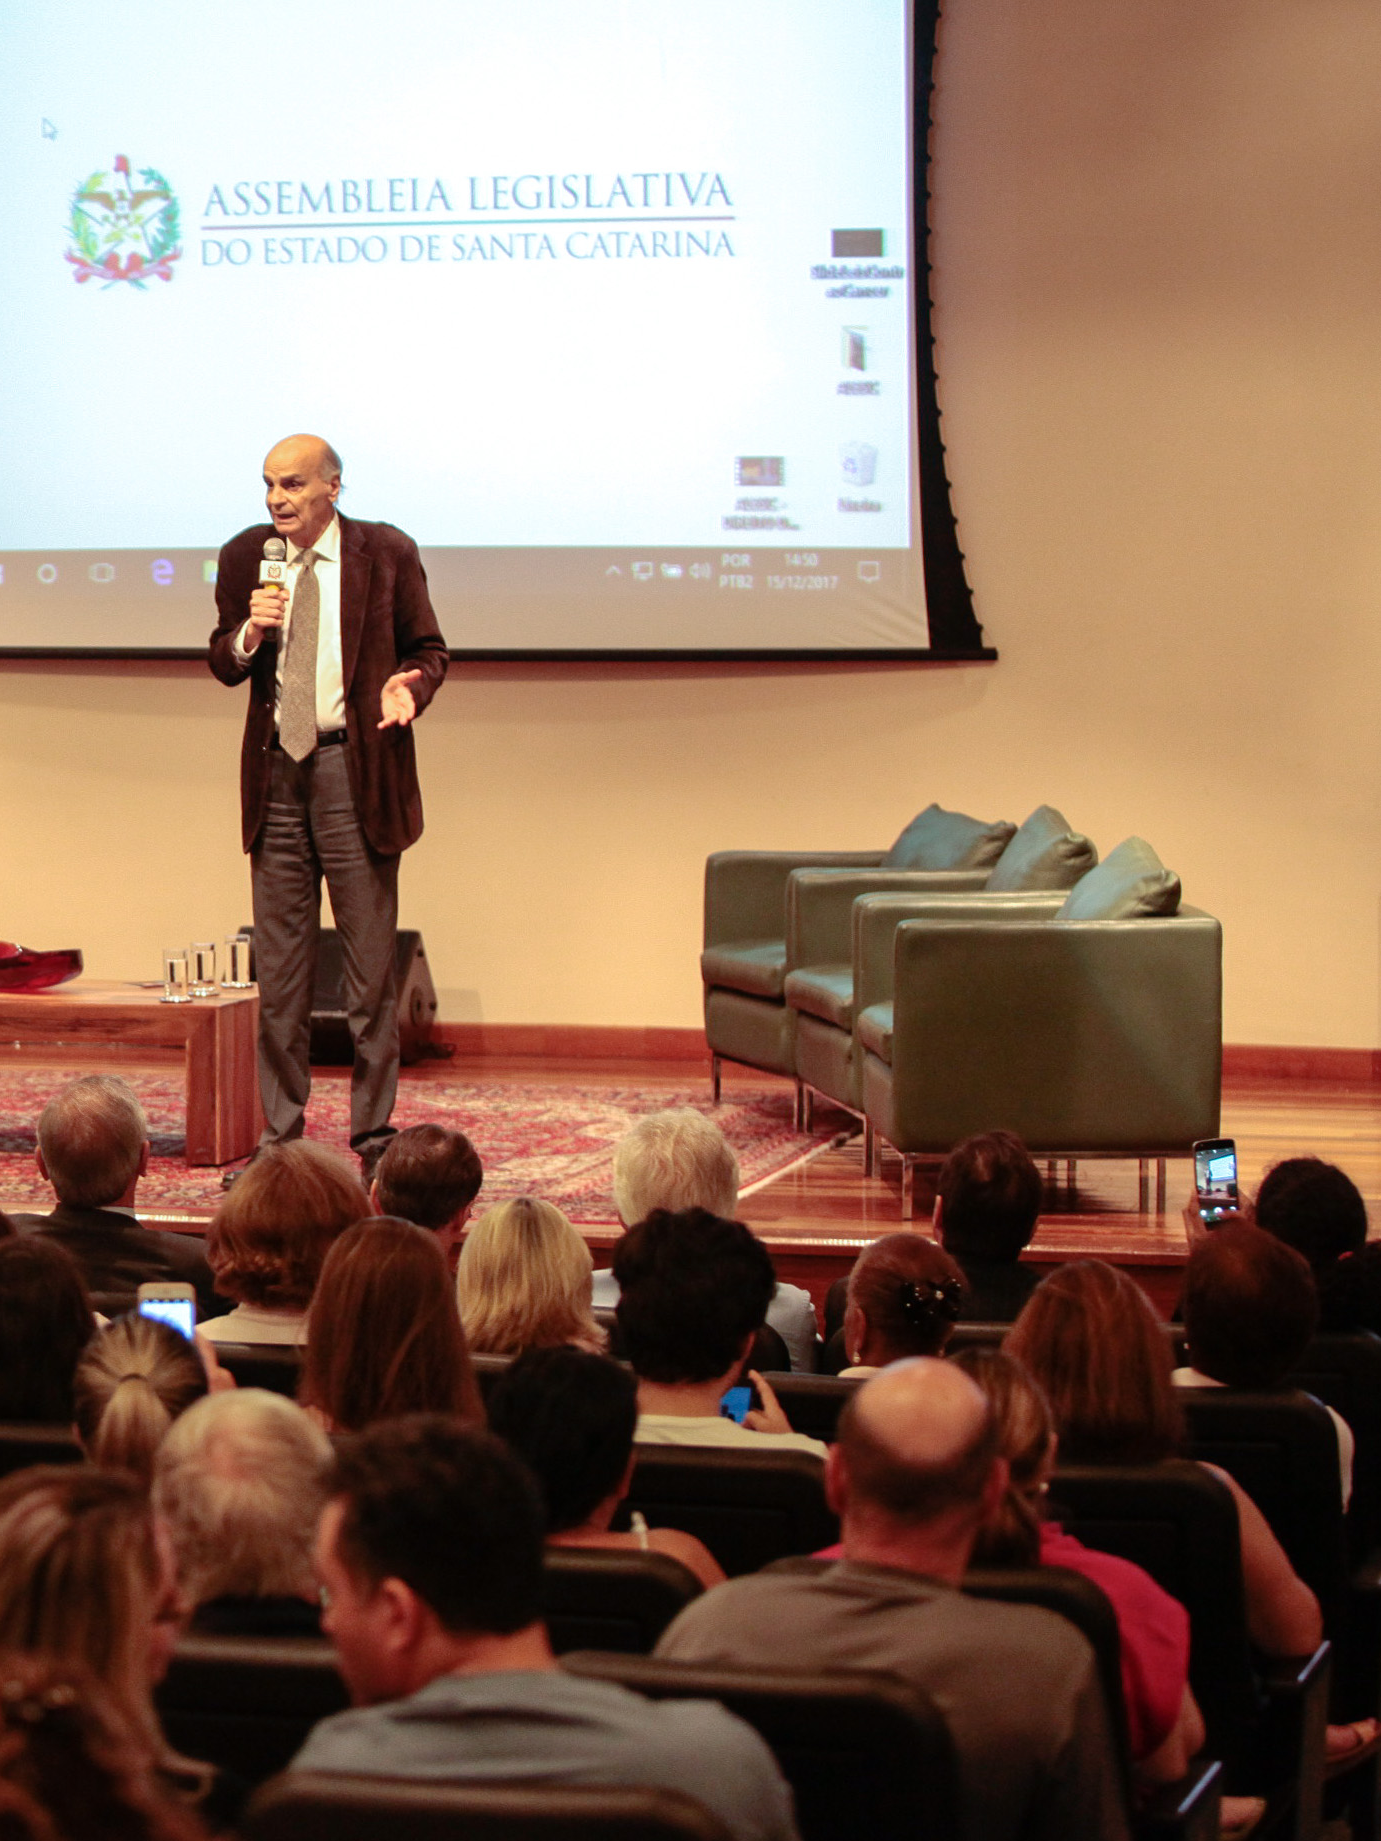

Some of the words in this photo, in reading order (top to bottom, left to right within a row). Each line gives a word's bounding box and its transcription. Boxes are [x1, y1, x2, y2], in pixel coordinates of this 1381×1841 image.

[203, 177, 454, 217] ASSEMBLEIA
[468, 171, 735, 211] LEGISLATIVA
[201, 237, 253, 267] DO
[263, 235, 389, 265] ESTADO
[400, 234, 442, 262] DE
[452, 232, 557, 261] SANTA
[565, 229, 737, 260] CATARINA
[721, 553, 751, 567] POR
